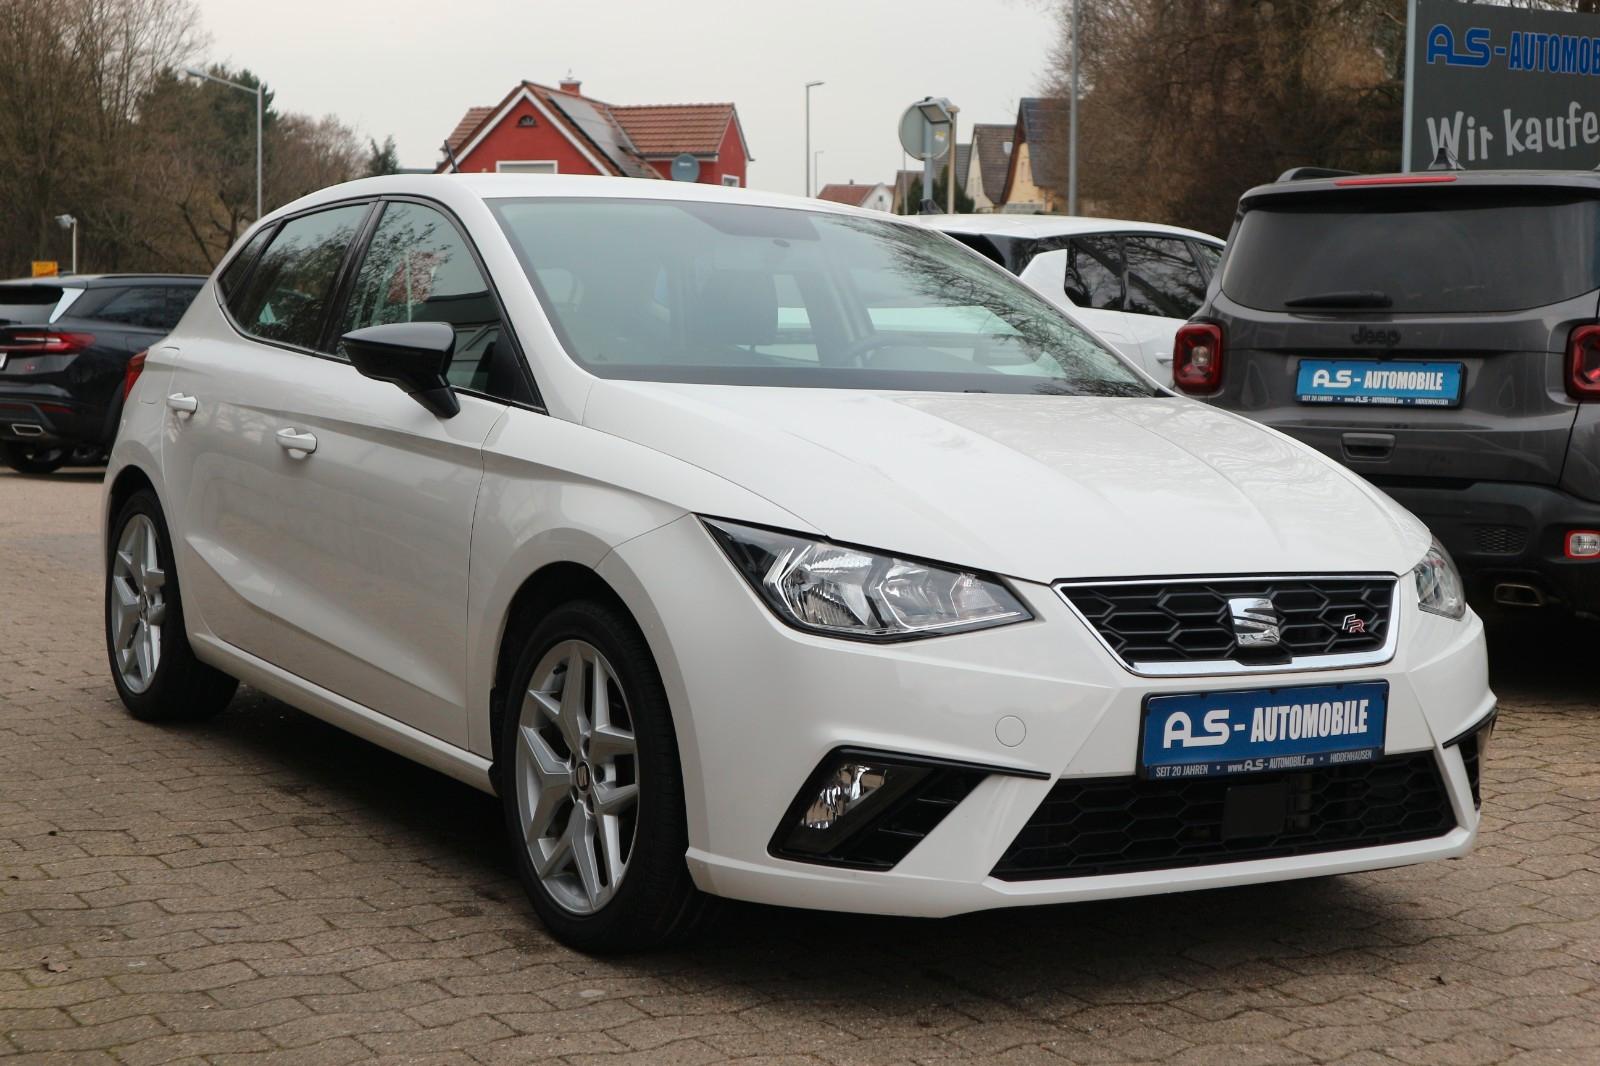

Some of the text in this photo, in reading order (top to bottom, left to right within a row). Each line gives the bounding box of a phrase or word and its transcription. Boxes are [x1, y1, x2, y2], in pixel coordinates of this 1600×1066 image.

[1426, 101, 1600, 161] Wir kaufe
[1352, 325, 1402, 347] Jeep
[1342, 613, 1365, 633] FR
[1163, 699, 1369, 749] AS-AUTOMOBILE
[1156, 766, 1171, 777] SEIT
[1171, 765, 1181, 776] 20
[1182, 764, 1209, 776] JAHREN
[1330, 749, 1373, 763] HIDDENHAUSEN
